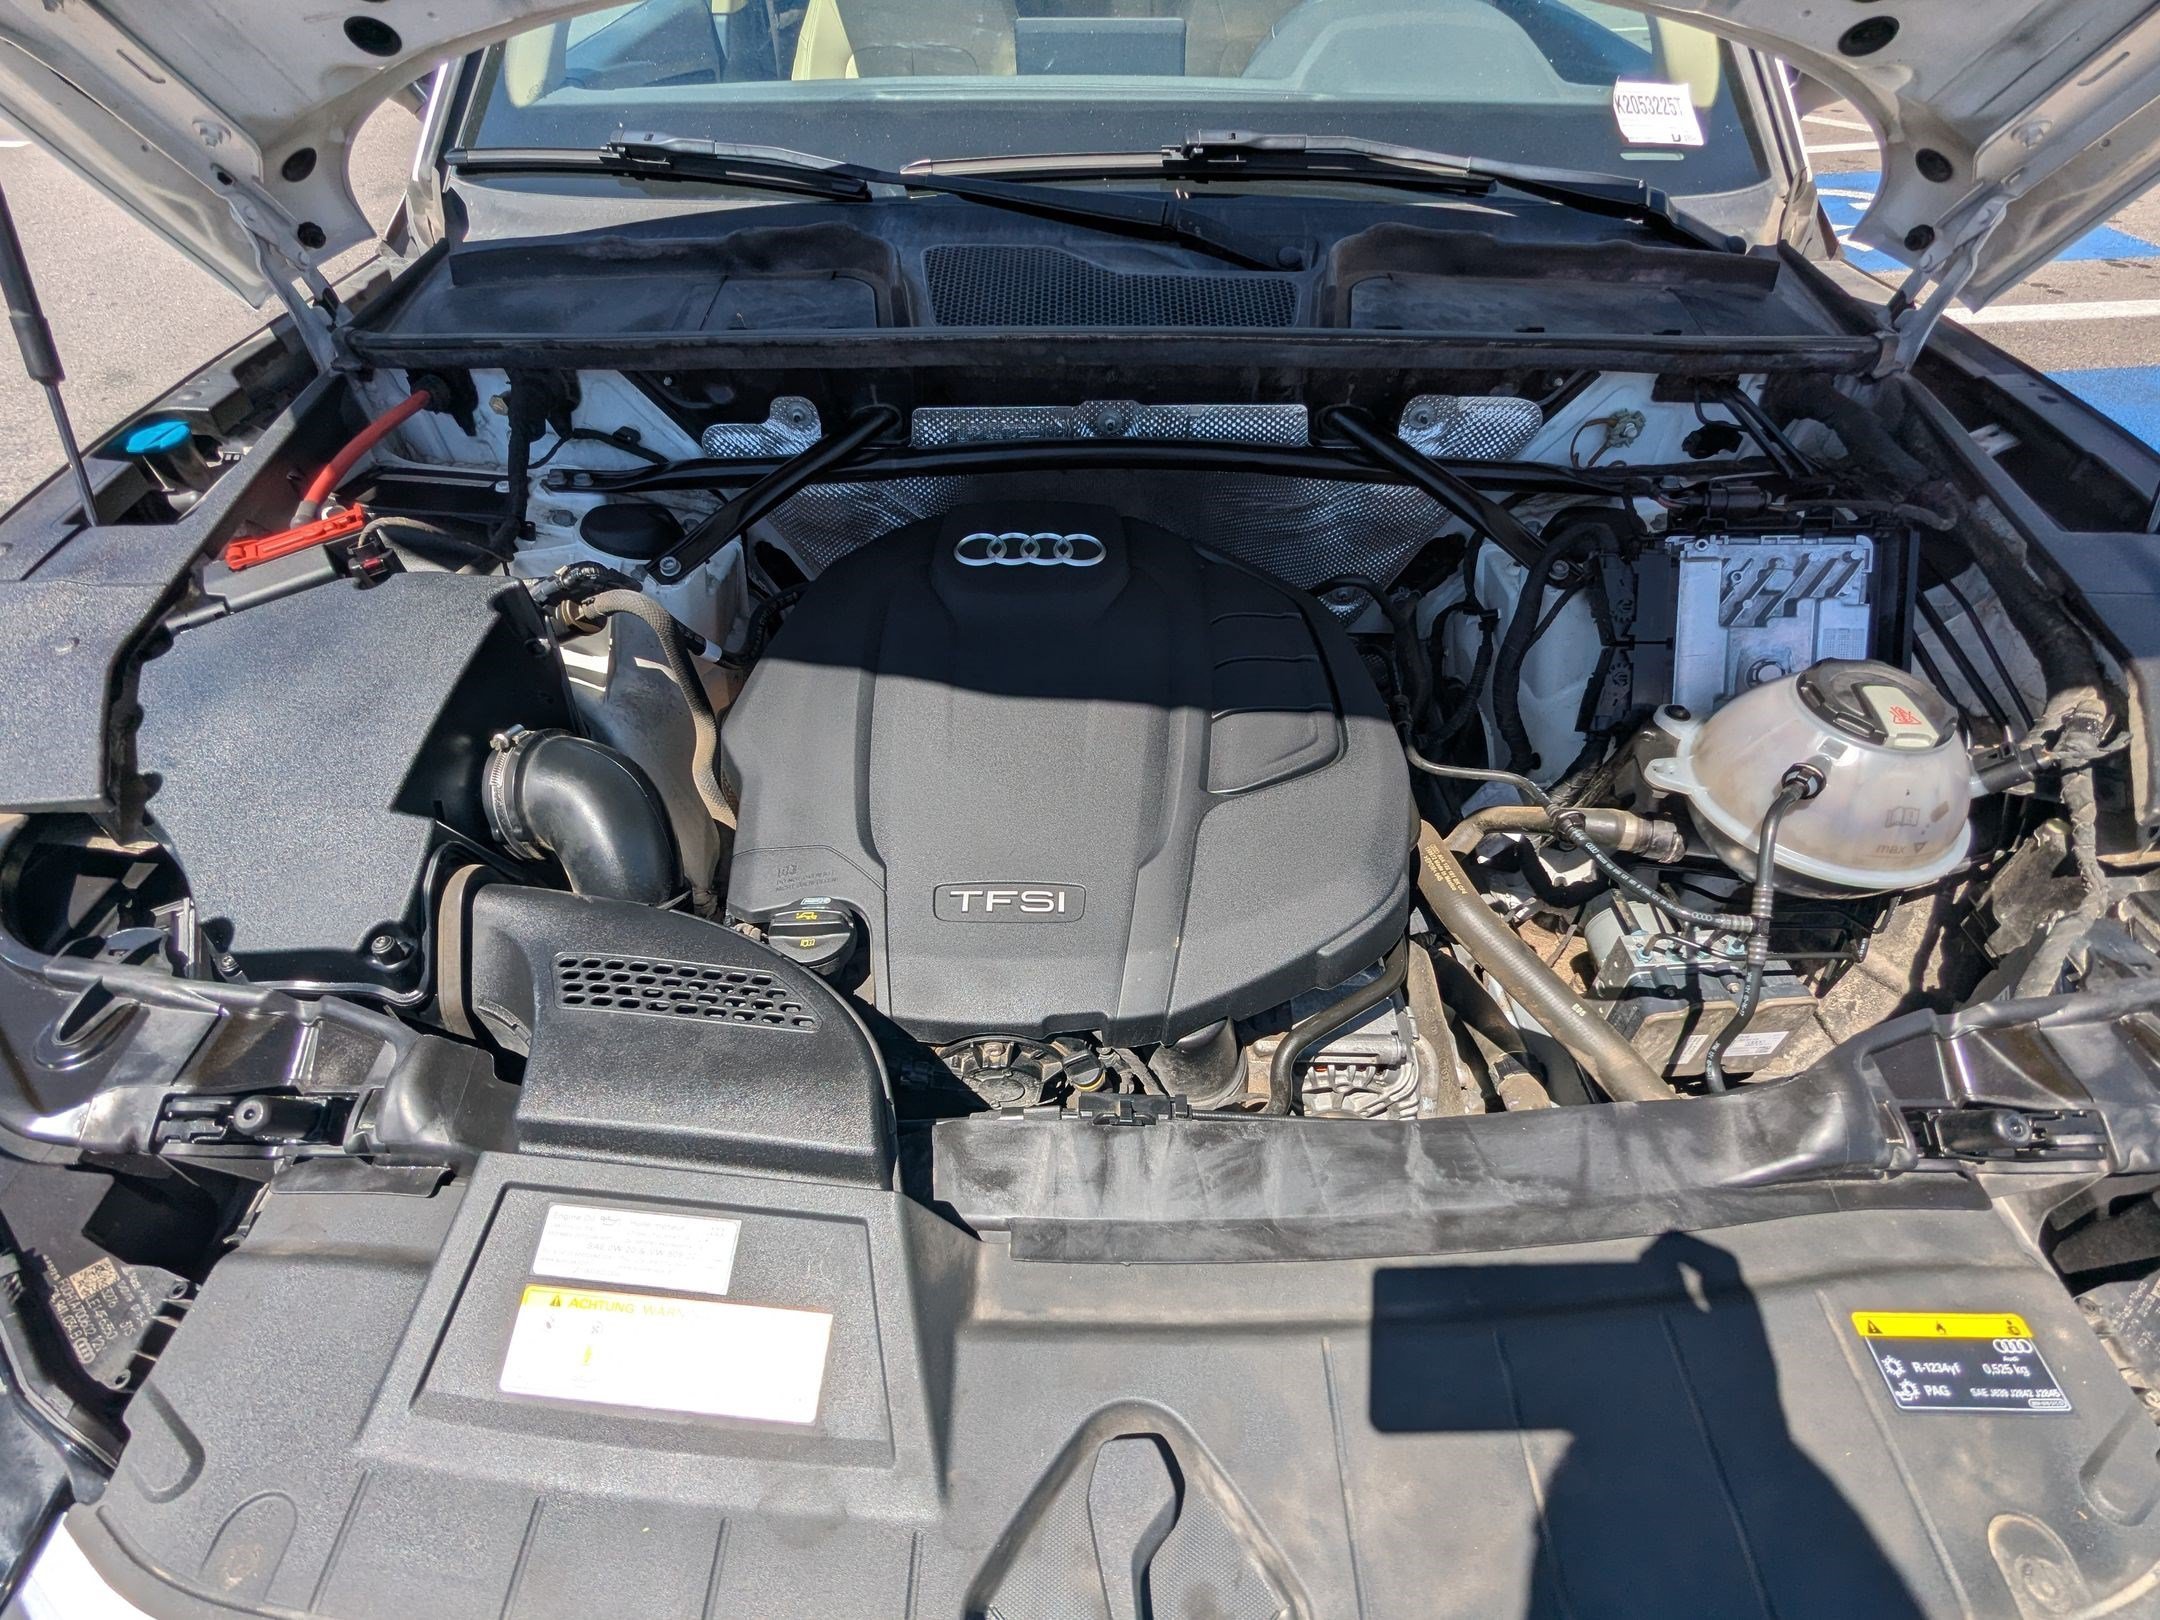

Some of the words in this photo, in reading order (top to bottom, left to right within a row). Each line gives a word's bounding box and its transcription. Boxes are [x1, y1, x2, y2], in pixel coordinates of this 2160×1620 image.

[1876, 845, 1906, 855] max
[950, 891, 1065, 913] TFSI
[552, 1210, 581, 1222] Engine
[567, 1296, 635, 1315] ACHTUNG
[1912, 1361, 1960, 1376] R-1234yf
[1982, 1363, 2014, 1376] 0,525
[2014, 1364, 2031, 1377] kg
[1923, 1384, 1951, 1397] PAG
[1970, 1388, 1989, 1398] SAE
